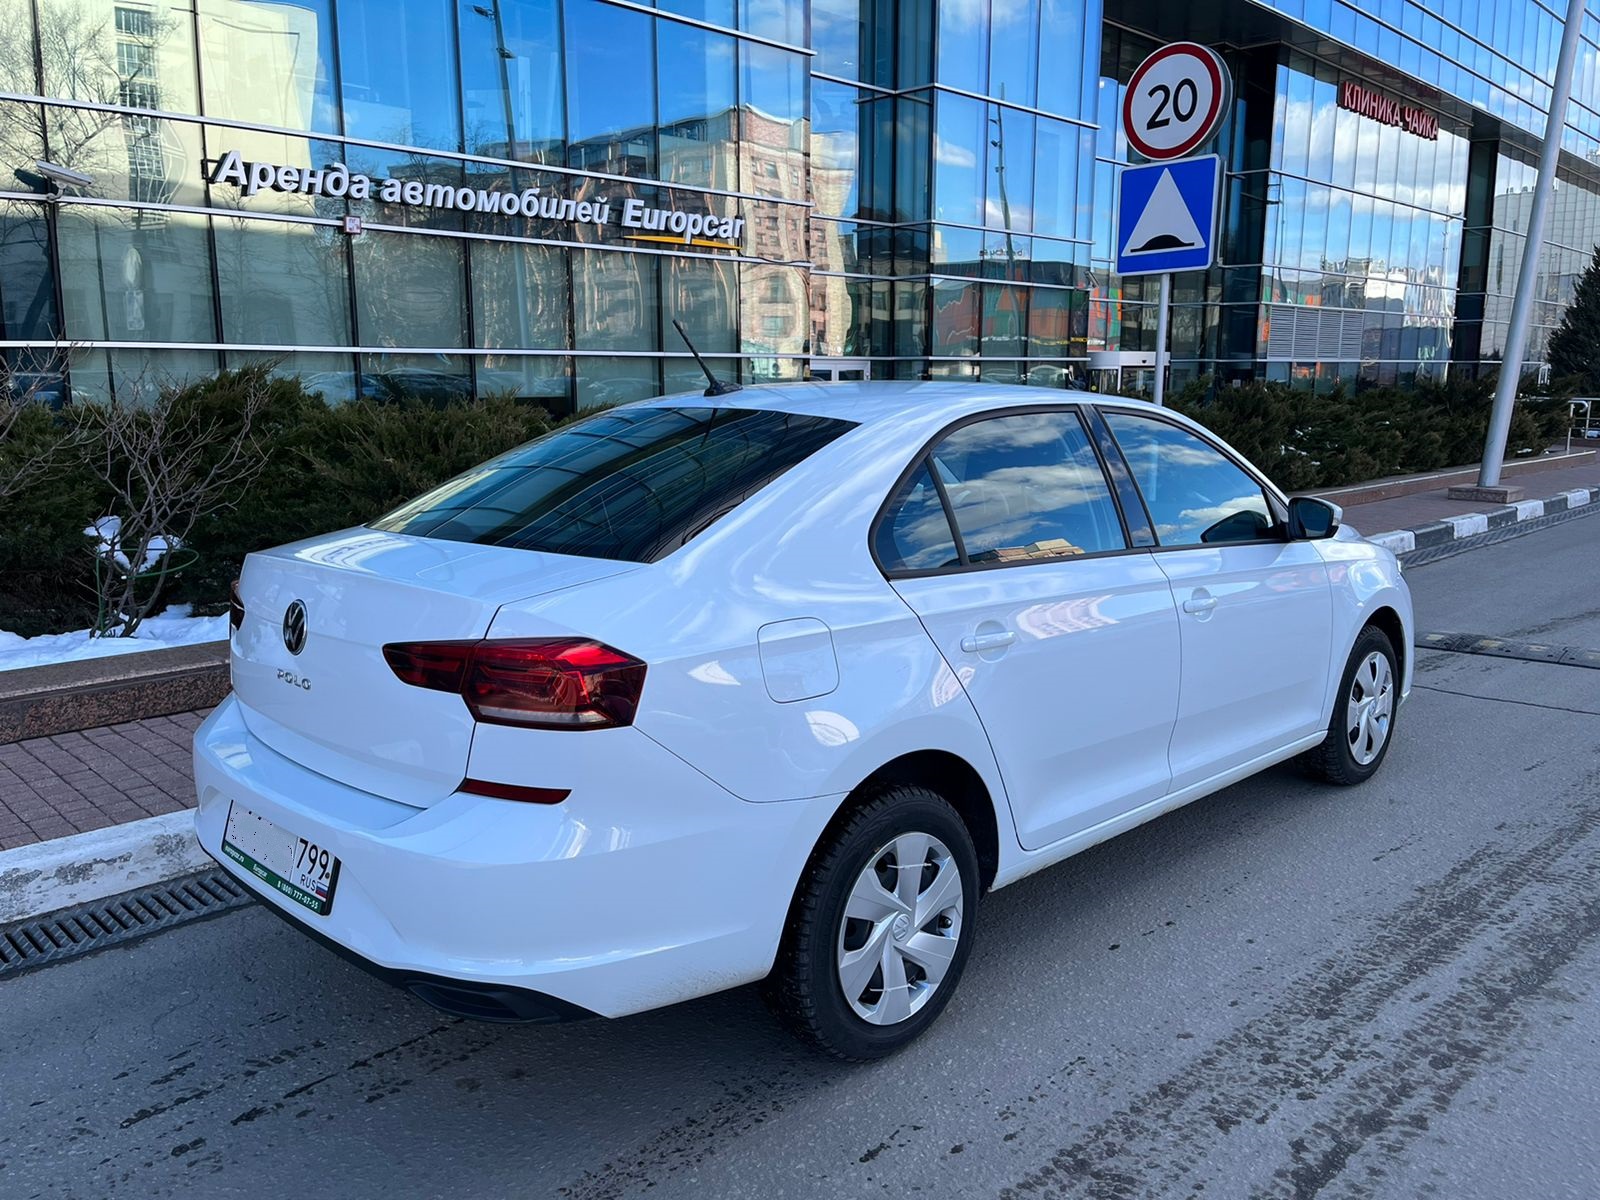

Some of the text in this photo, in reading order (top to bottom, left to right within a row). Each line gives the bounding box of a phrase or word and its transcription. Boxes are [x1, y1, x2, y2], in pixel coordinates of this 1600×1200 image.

[1146, 78, 1198, 130] 20
[1343, 81, 1401, 126] КЛИНИКА
[215, 150, 746, 245] Аренда автомобилей Europcar
[277, 668, 312, 691] POLO
[296, 837, 329, 881] 799
[300, 873, 316, 892] RUS
